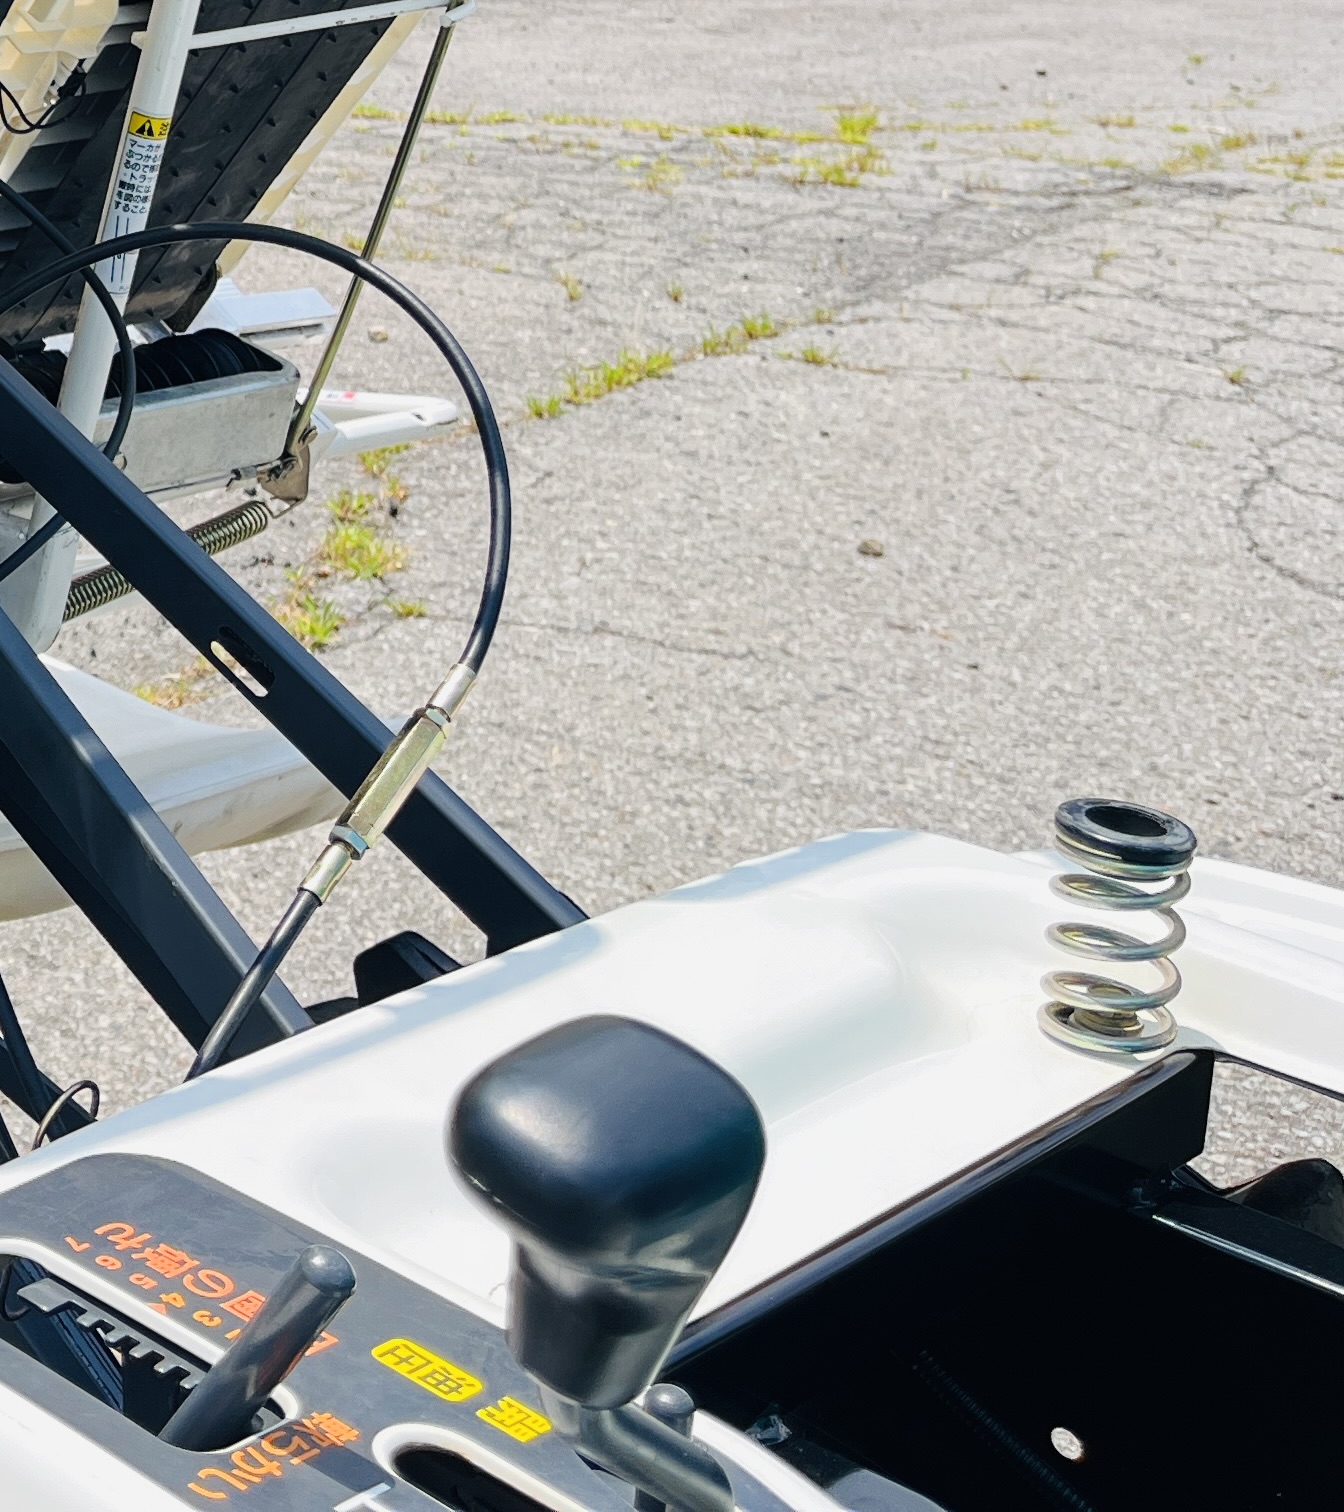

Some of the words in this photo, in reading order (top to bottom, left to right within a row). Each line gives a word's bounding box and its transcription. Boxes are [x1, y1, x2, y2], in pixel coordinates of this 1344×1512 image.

[64, 1236, 92, 1253] 7
[95, 1255, 123, 1270] 6
[128, 1273, 159, 1290] 5
[159, 1292, 186, 1308] 4
[192, 1310, 223, 1327] 3
[375, 1341, 480, 1398] 油圧
